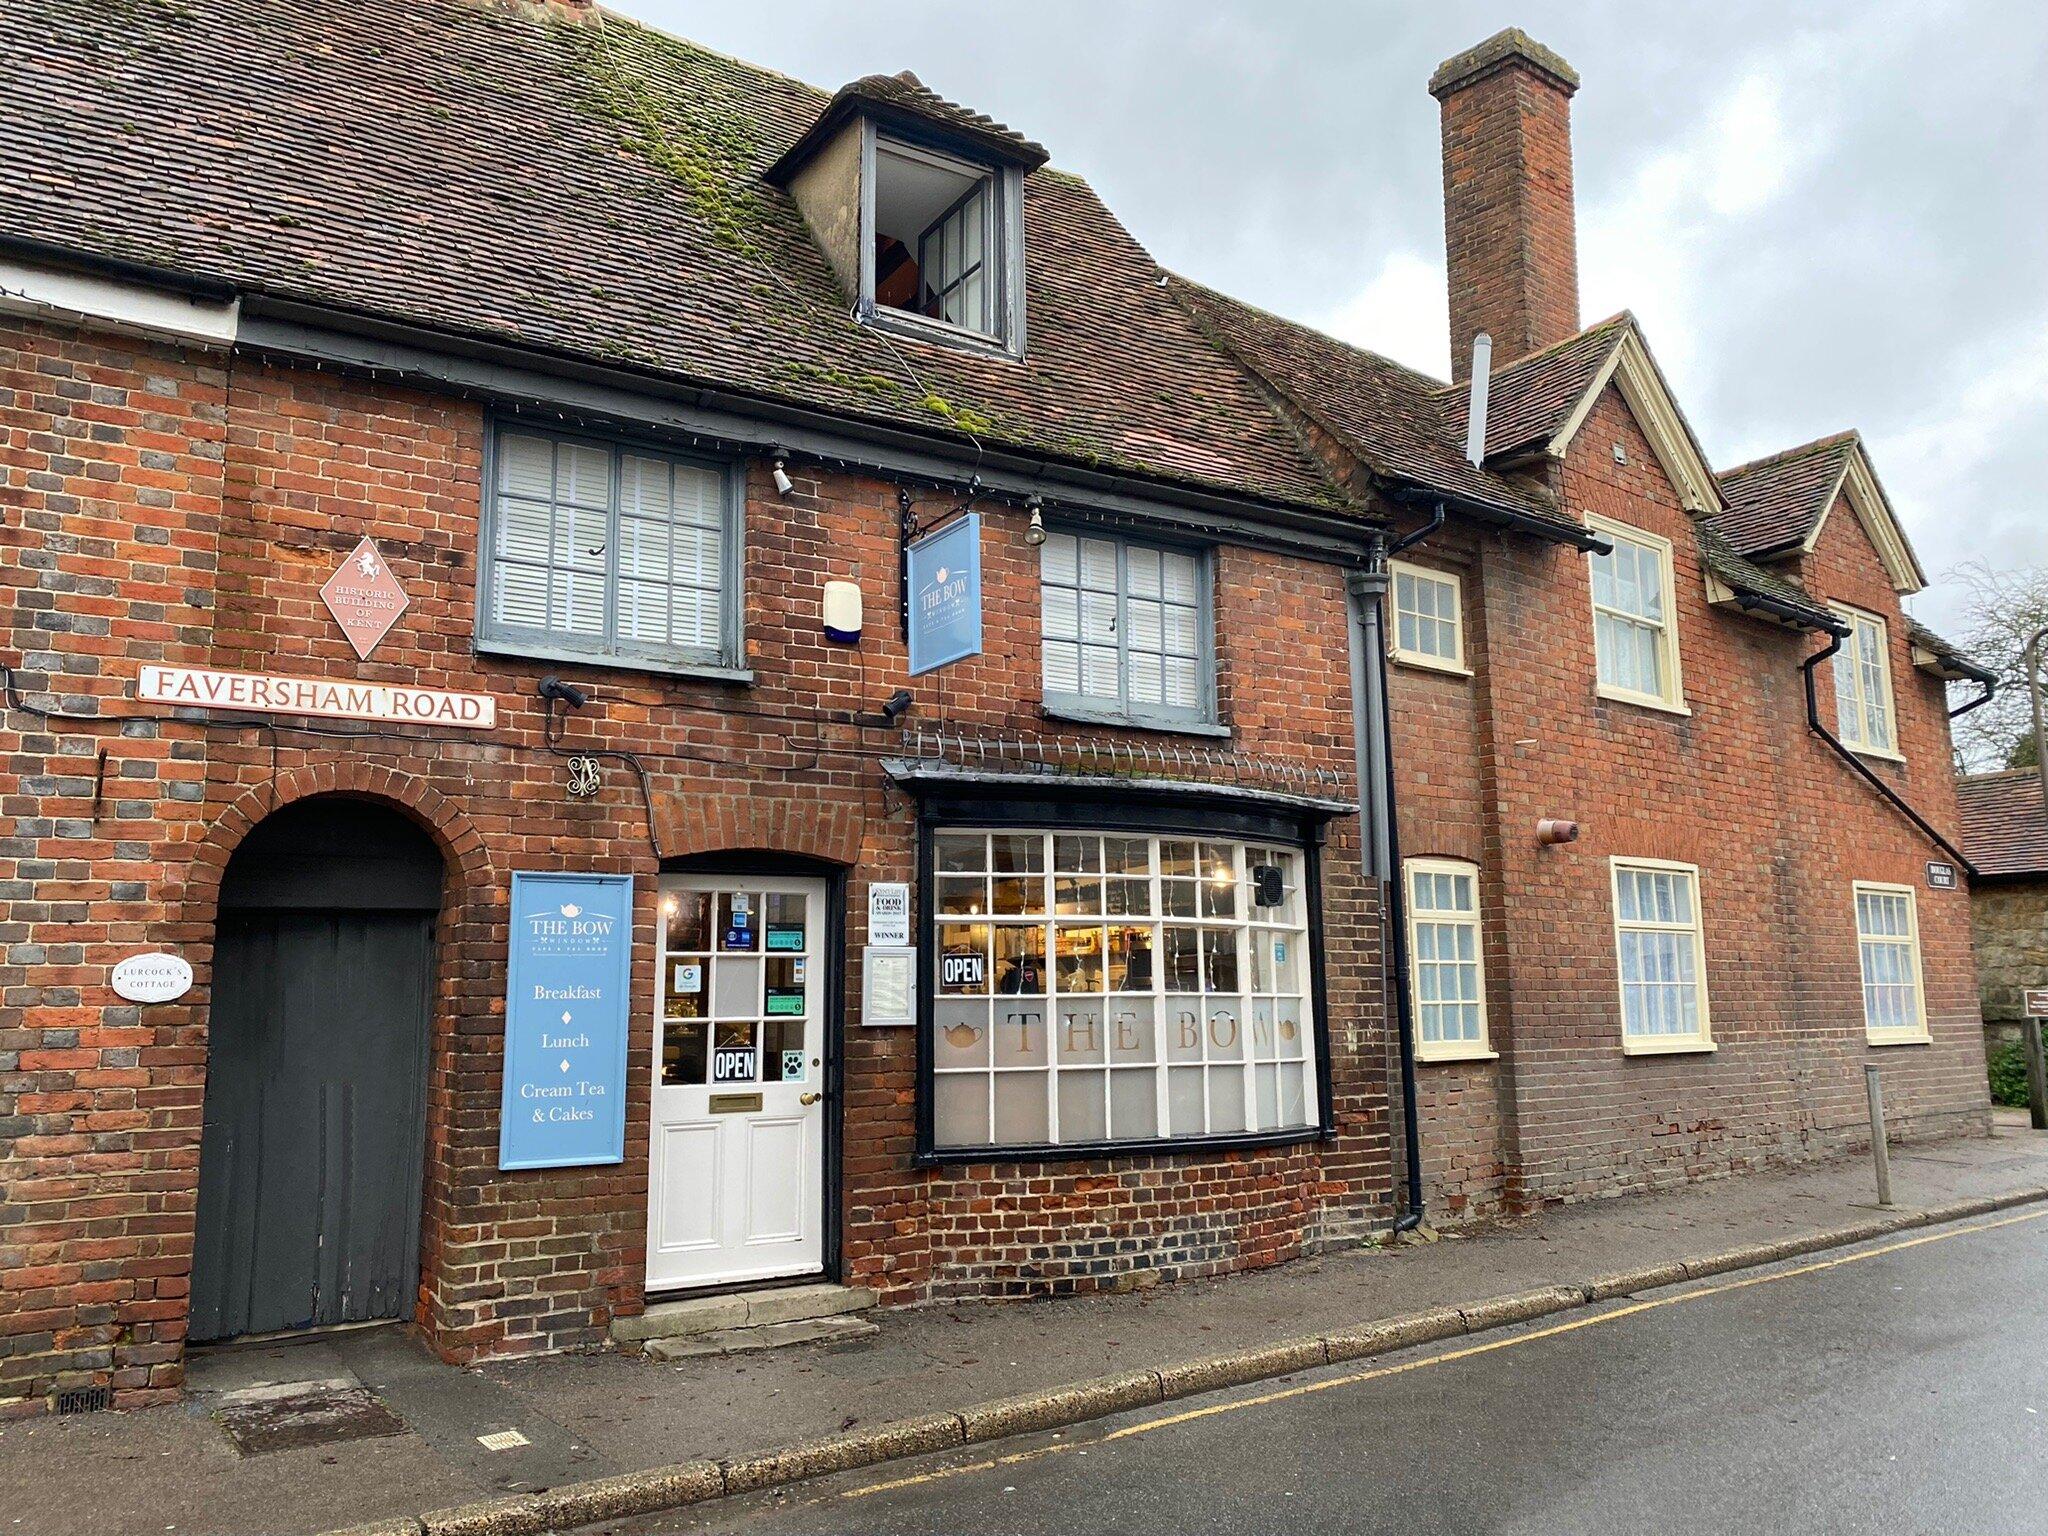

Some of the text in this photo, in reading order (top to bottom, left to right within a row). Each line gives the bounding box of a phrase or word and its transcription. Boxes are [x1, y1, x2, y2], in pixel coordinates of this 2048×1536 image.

[335, 585, 395, 601] HISTORIC
[922, 588, 942, 611] THE
[943, 577, 968, 602] BOW
[334, 596, 395, 610] BUILDING
[356, 608, 373, 618] OF
[347, 618, 382, 629] KENT
[156, 671, 481, 721] FAVERSHAM ROAD
[876, 898, 902, 906] FOOD
[529, 920, 614, 936] THE BOW
[944, 958, 982, 983] OPEN
[129, 980, 177, 989] COTTAGE
[533, 985, 602, 1001] Breakfast
[1007, 1012, 1140, 1052] THE
[542, 1033, 590, 1049] Lunch
[715, 1052, 754, 1079] OPEN
[521, 1081, 606, 1099] Cream Tea
[532, 1106, 594, 1123] & Cakes
